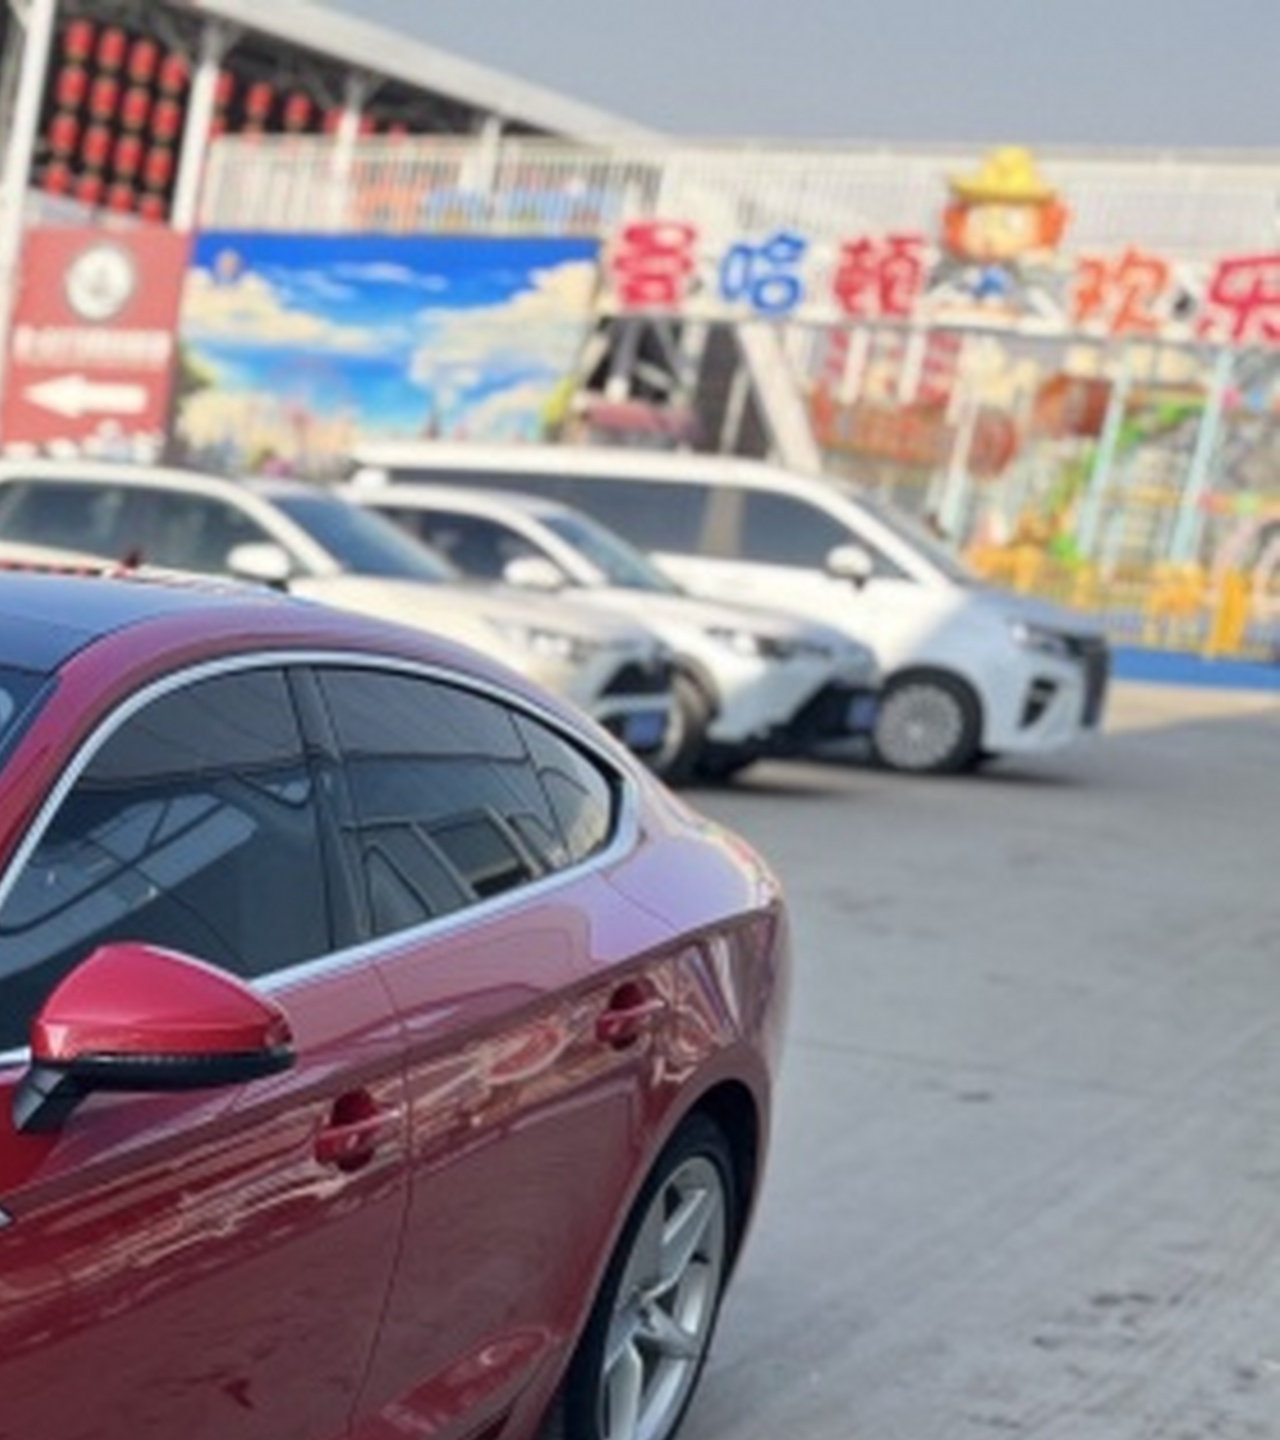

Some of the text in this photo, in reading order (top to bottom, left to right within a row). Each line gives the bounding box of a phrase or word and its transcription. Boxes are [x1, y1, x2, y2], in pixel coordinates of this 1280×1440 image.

[612, 221, 1280, 340] 曼哈顿 欢乐
